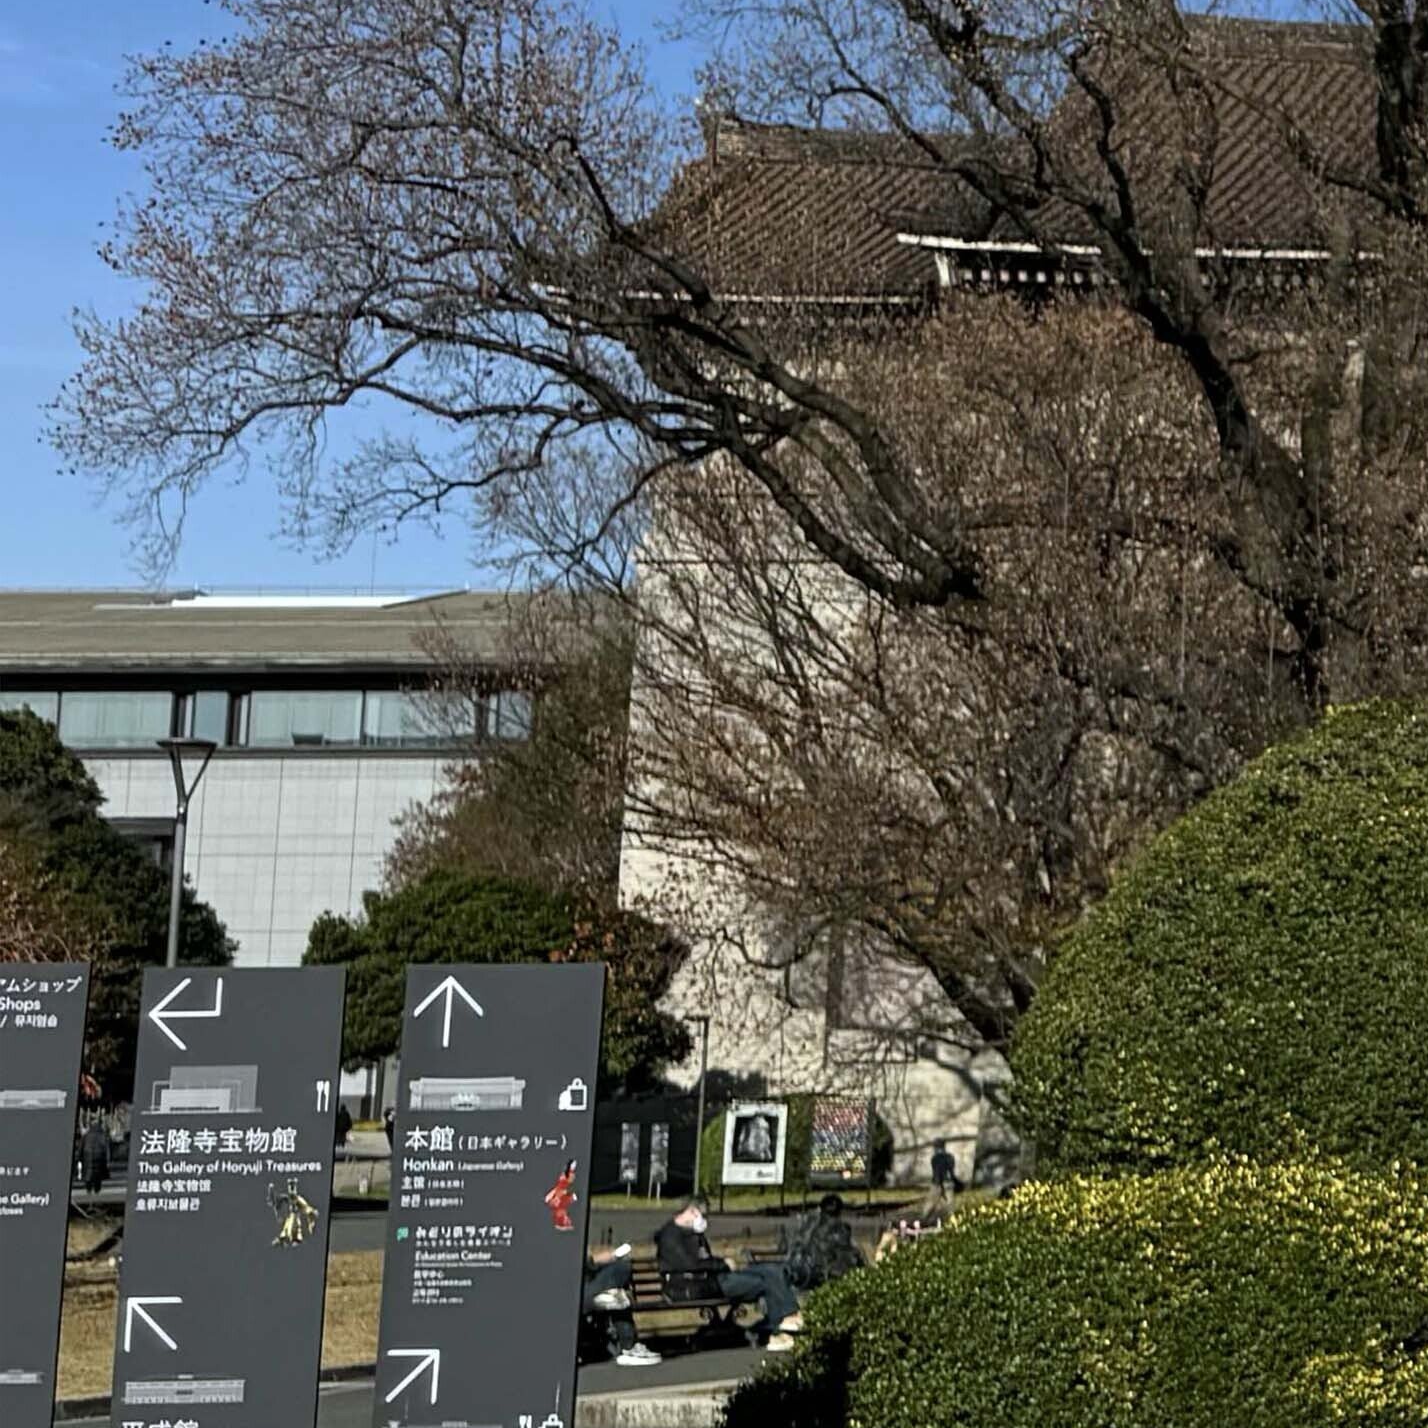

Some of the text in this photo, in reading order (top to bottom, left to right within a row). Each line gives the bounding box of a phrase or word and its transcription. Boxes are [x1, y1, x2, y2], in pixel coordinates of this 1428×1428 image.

[0, 996, 41, 1014] Shops
[140, 1127, 297, 1154] 法隆寺宝物館
[405, 1125, 455, 1152] 本館
[138, 1159, 322, 1176] The Gallery of Horyuji Treasures
[403, 1157, 454, 1172] Honkan
